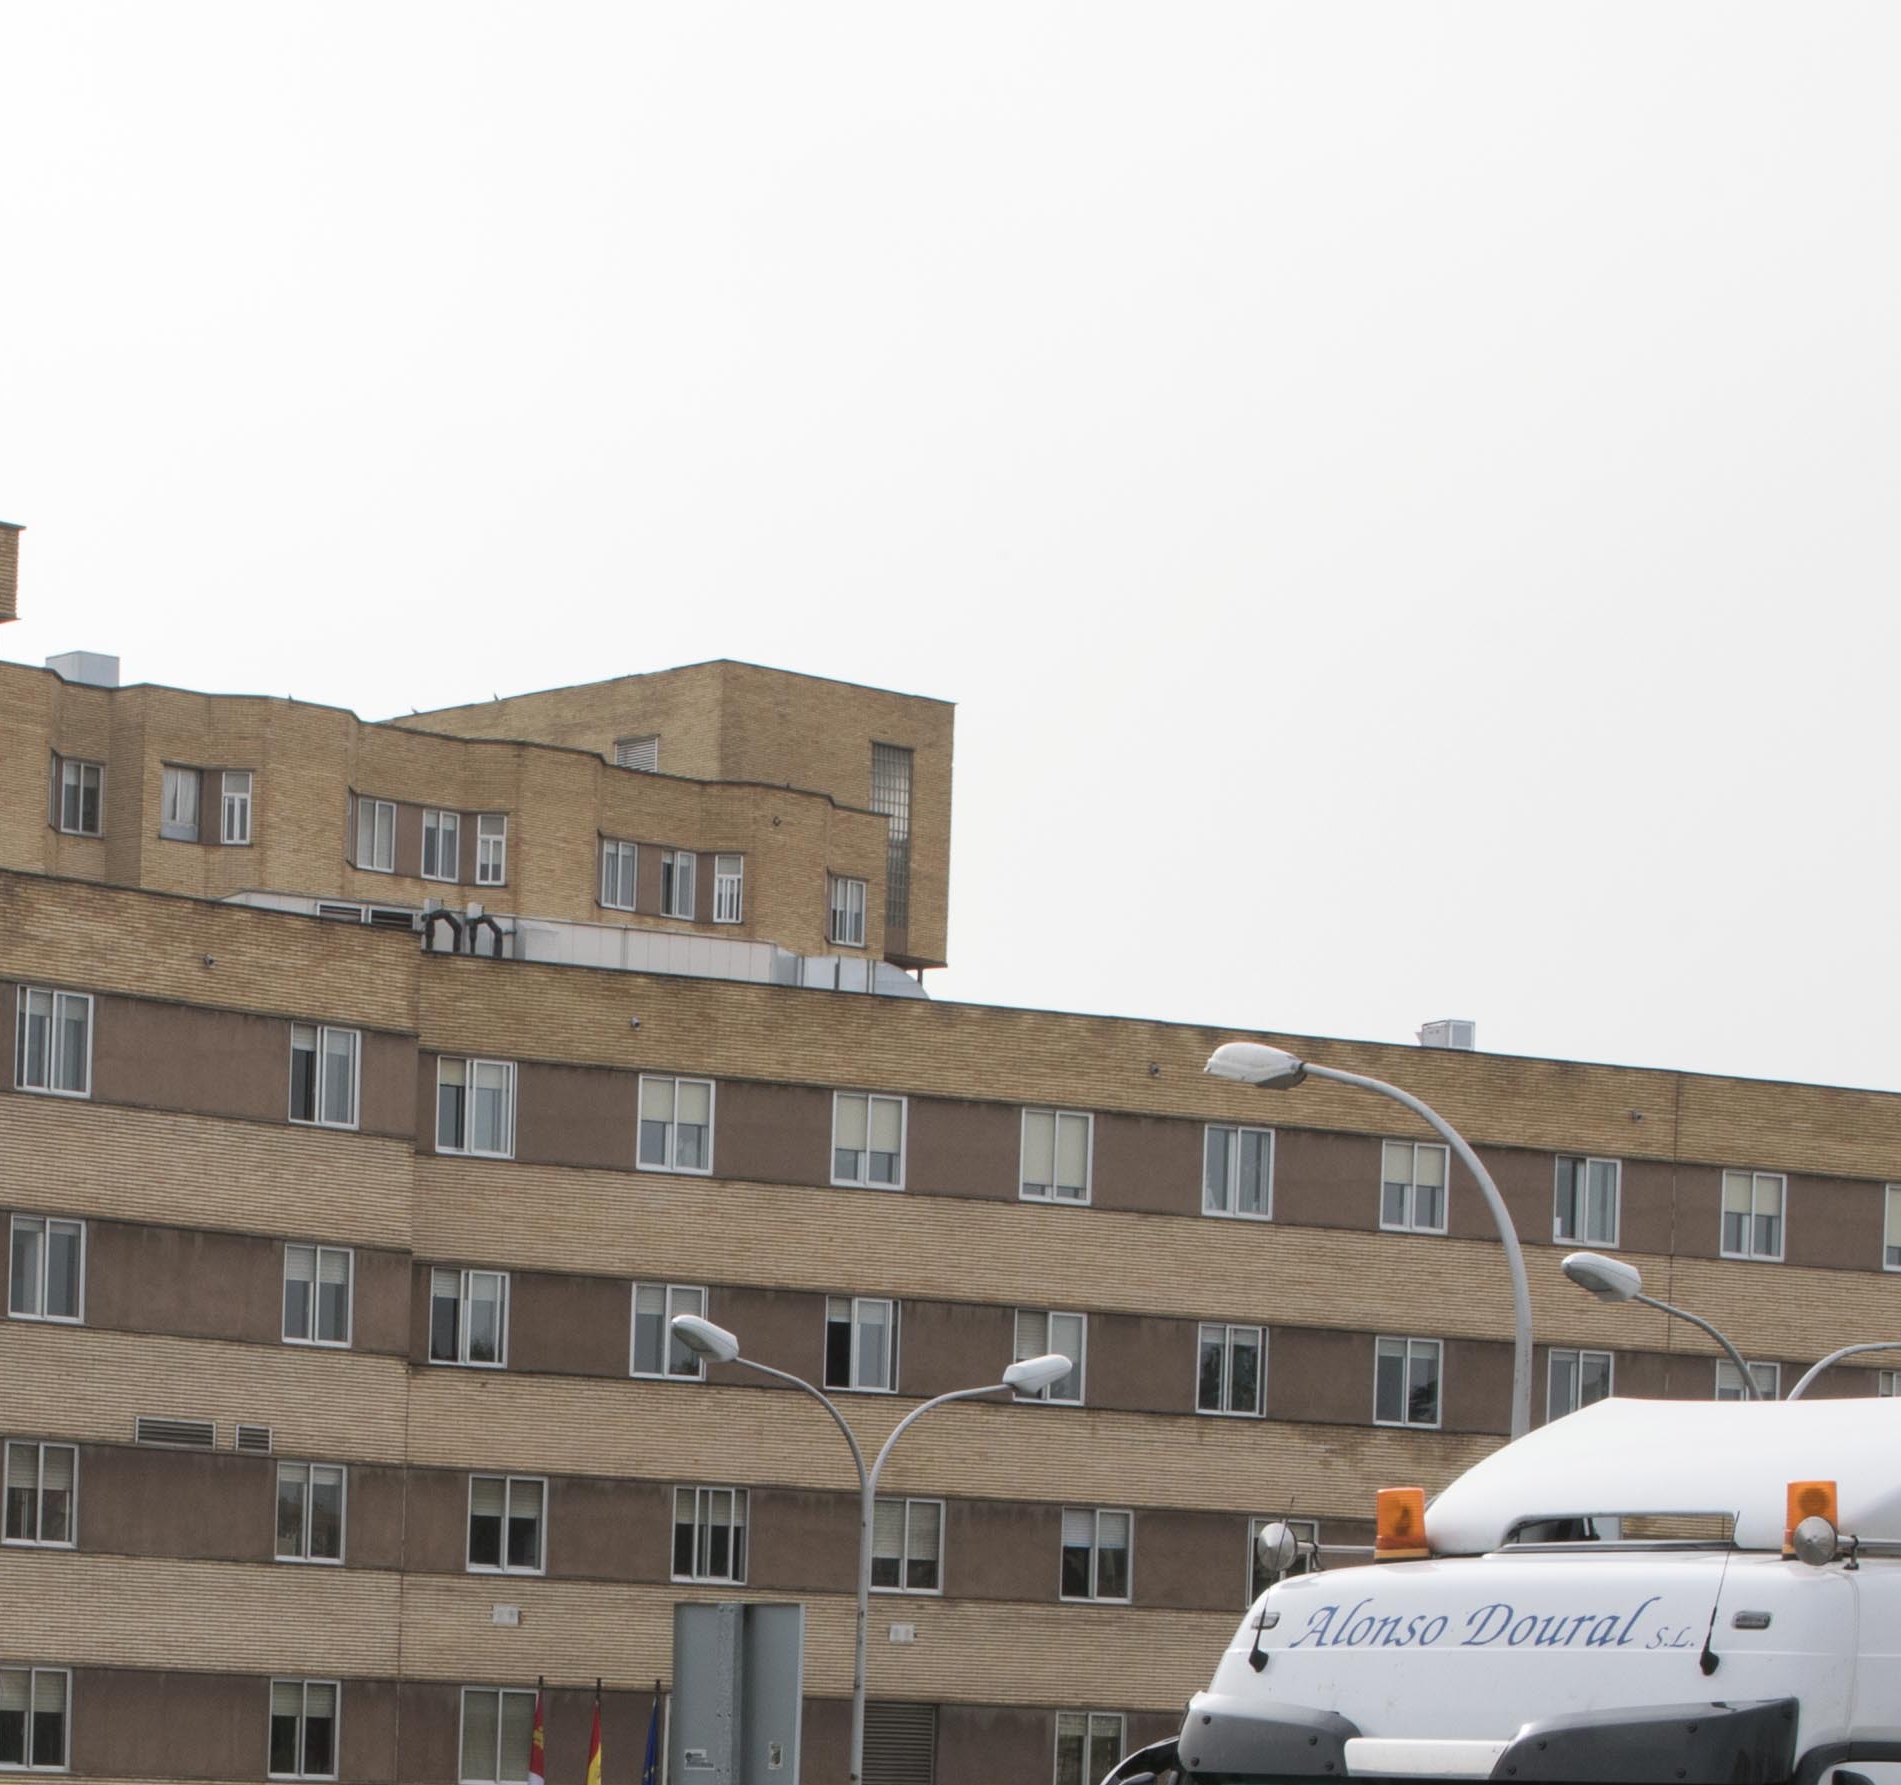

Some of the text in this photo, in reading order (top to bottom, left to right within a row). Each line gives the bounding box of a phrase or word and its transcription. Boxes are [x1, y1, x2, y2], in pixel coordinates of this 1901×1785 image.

[1289, 1596, 1695, 1650] Alonso Doural S.L.
